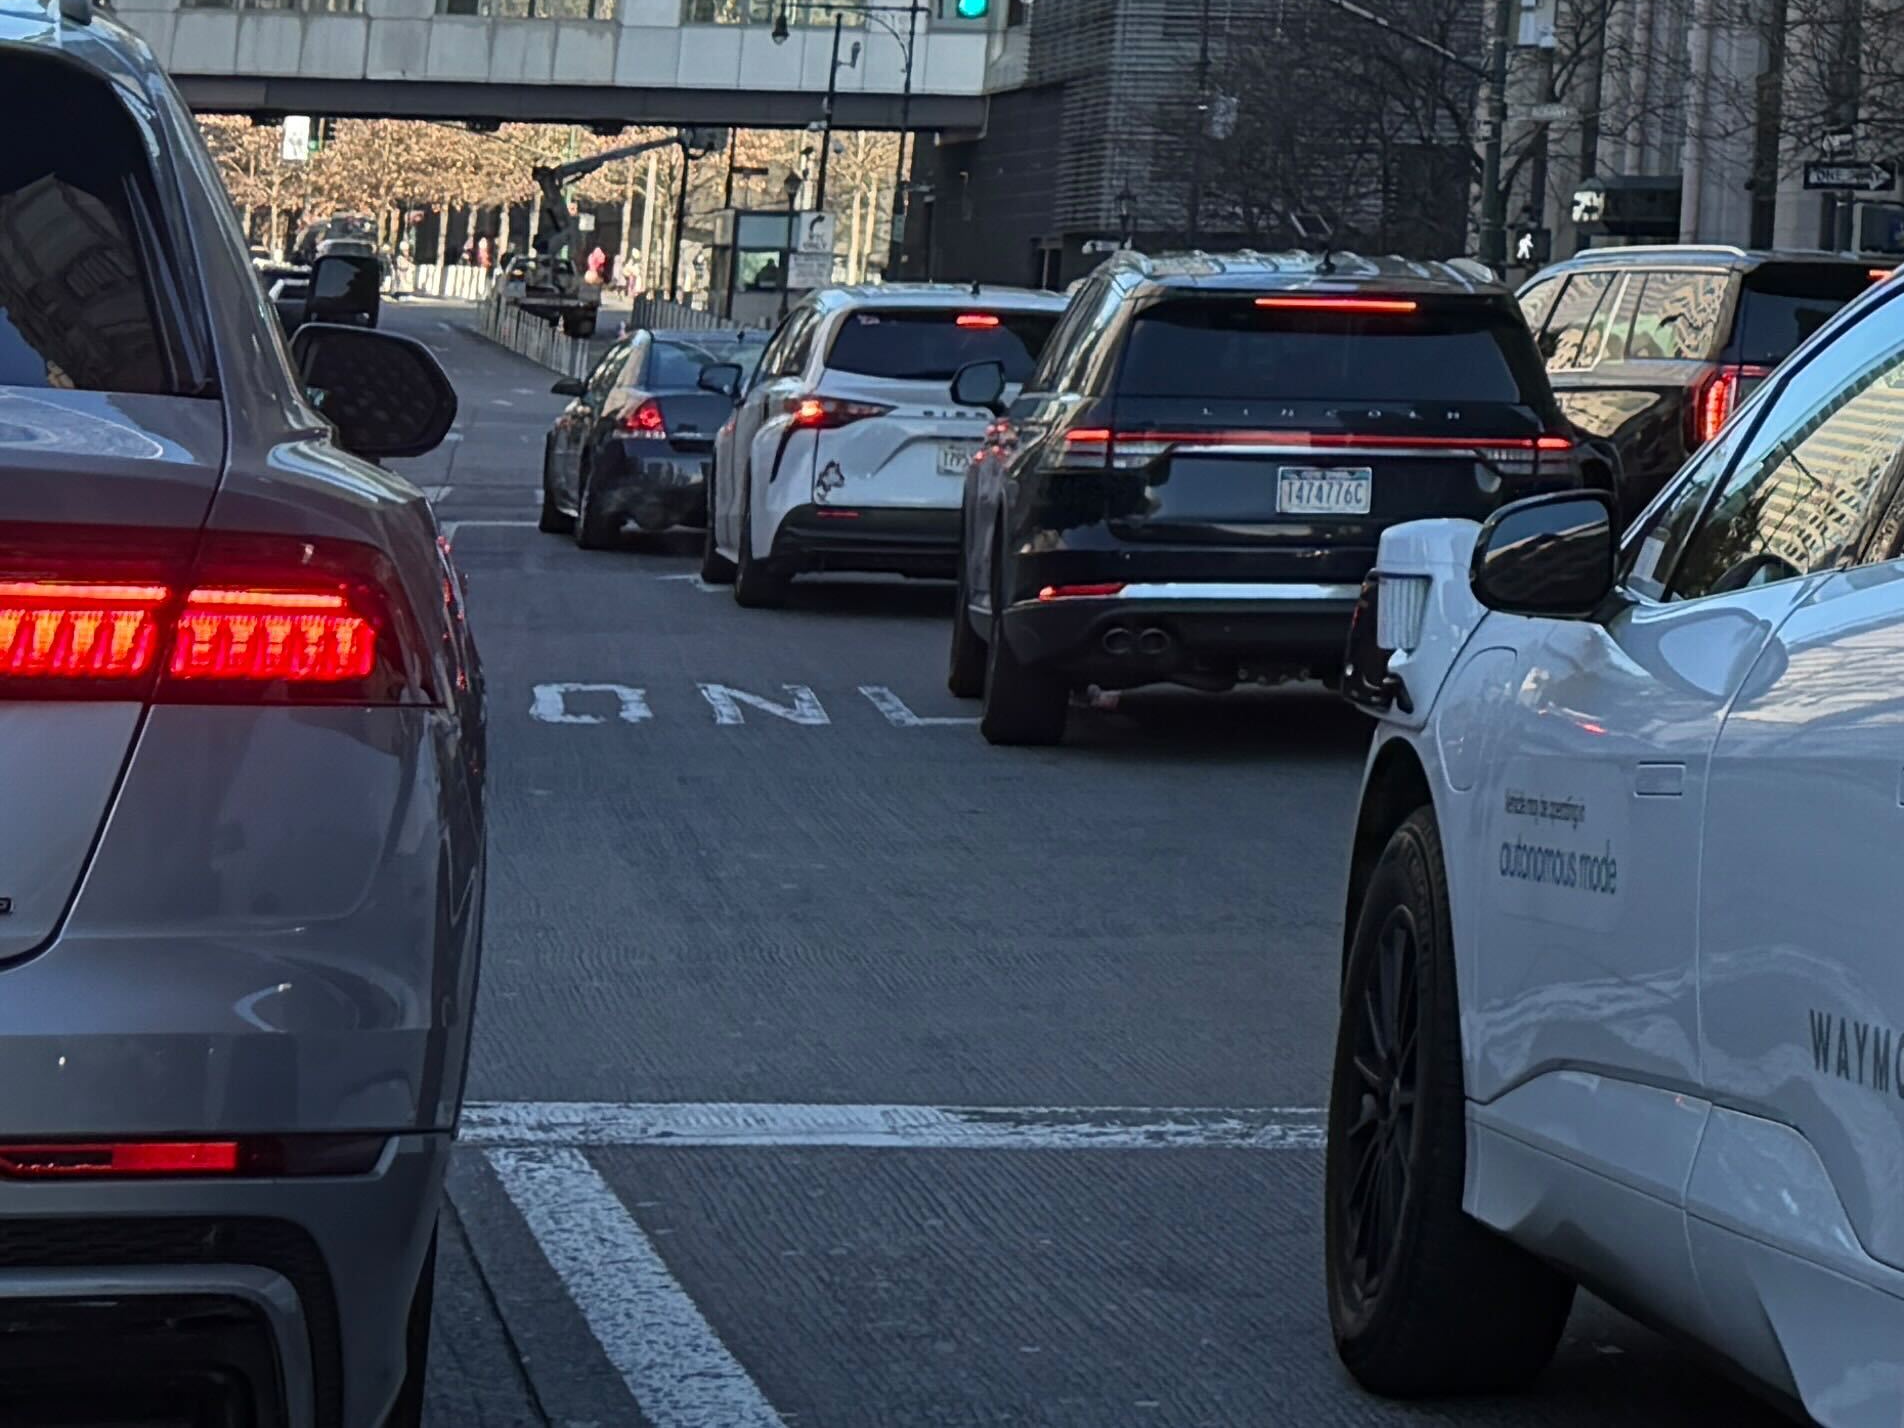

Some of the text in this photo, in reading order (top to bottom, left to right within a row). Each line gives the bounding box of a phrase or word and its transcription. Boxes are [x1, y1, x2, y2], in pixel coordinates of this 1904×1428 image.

[529, 681, 982, 727] ONL
[1500, 832, 1617, 895] autonomous mode
